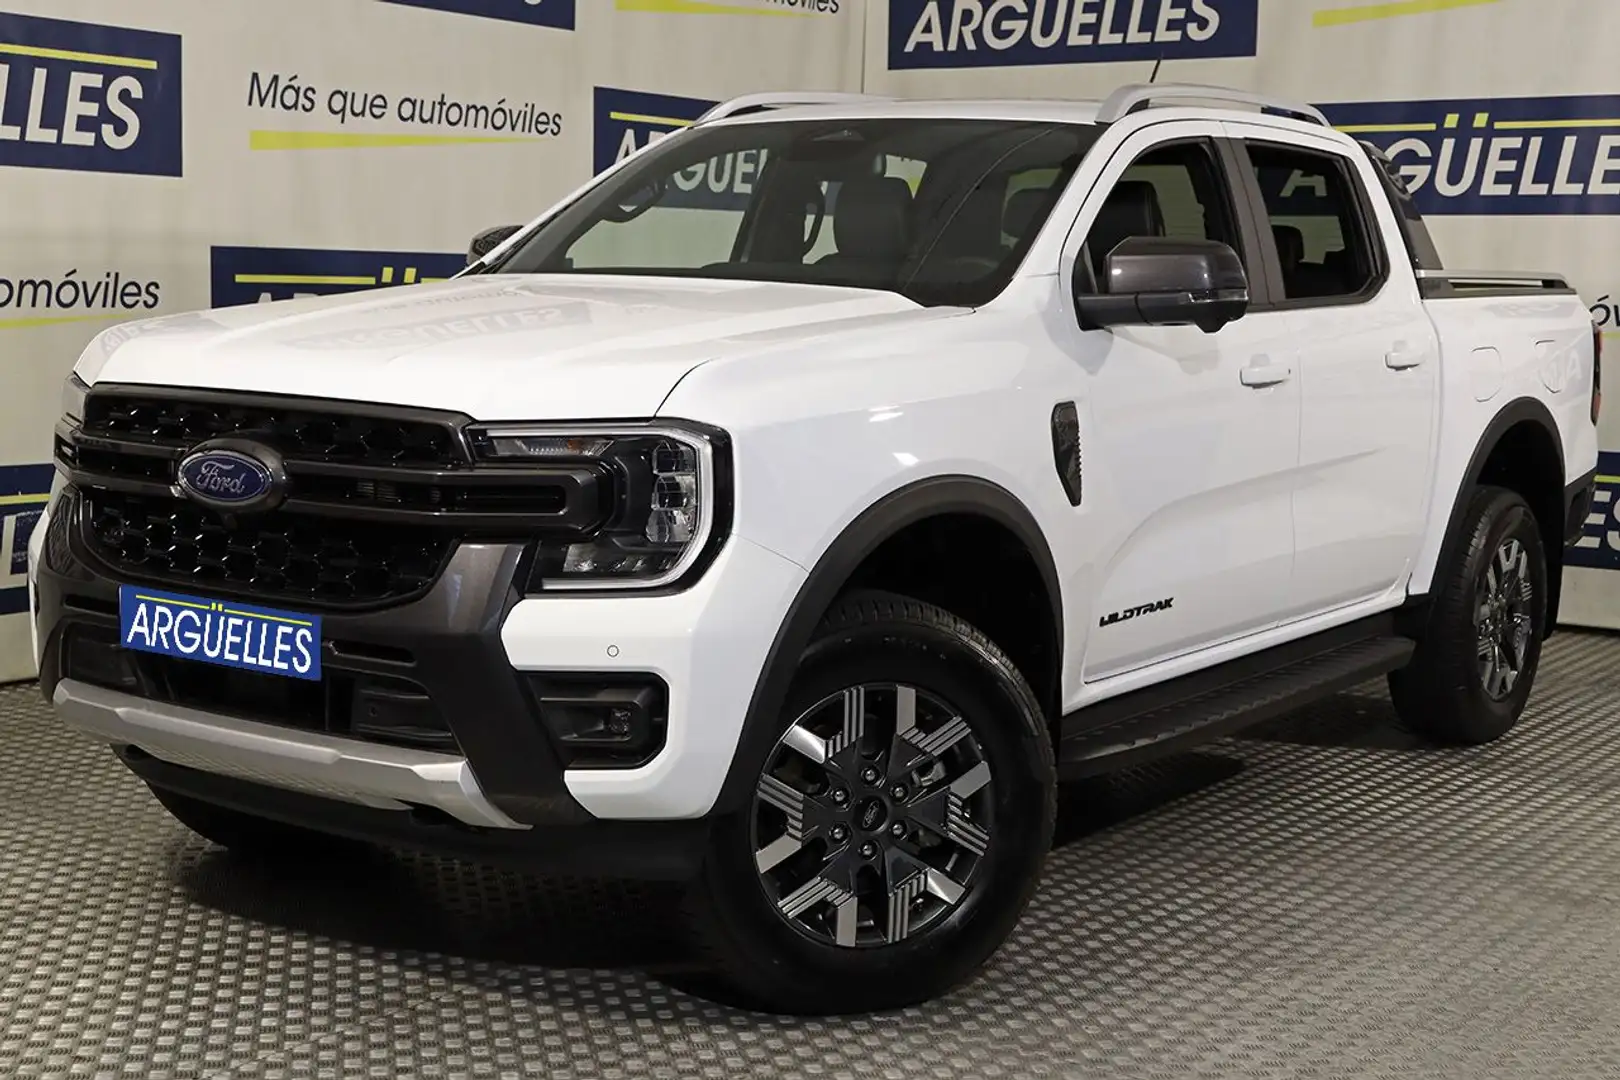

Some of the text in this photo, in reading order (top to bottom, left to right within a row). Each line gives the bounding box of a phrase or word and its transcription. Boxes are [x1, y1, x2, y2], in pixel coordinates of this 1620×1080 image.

[247, 72, 562, 136] Más que automóviles
[196, 460, 247, 493] Ford
[1099, 597, 1174, 627] WILDTRAK
[127, 602, 313, 673] ARGÜELLES
